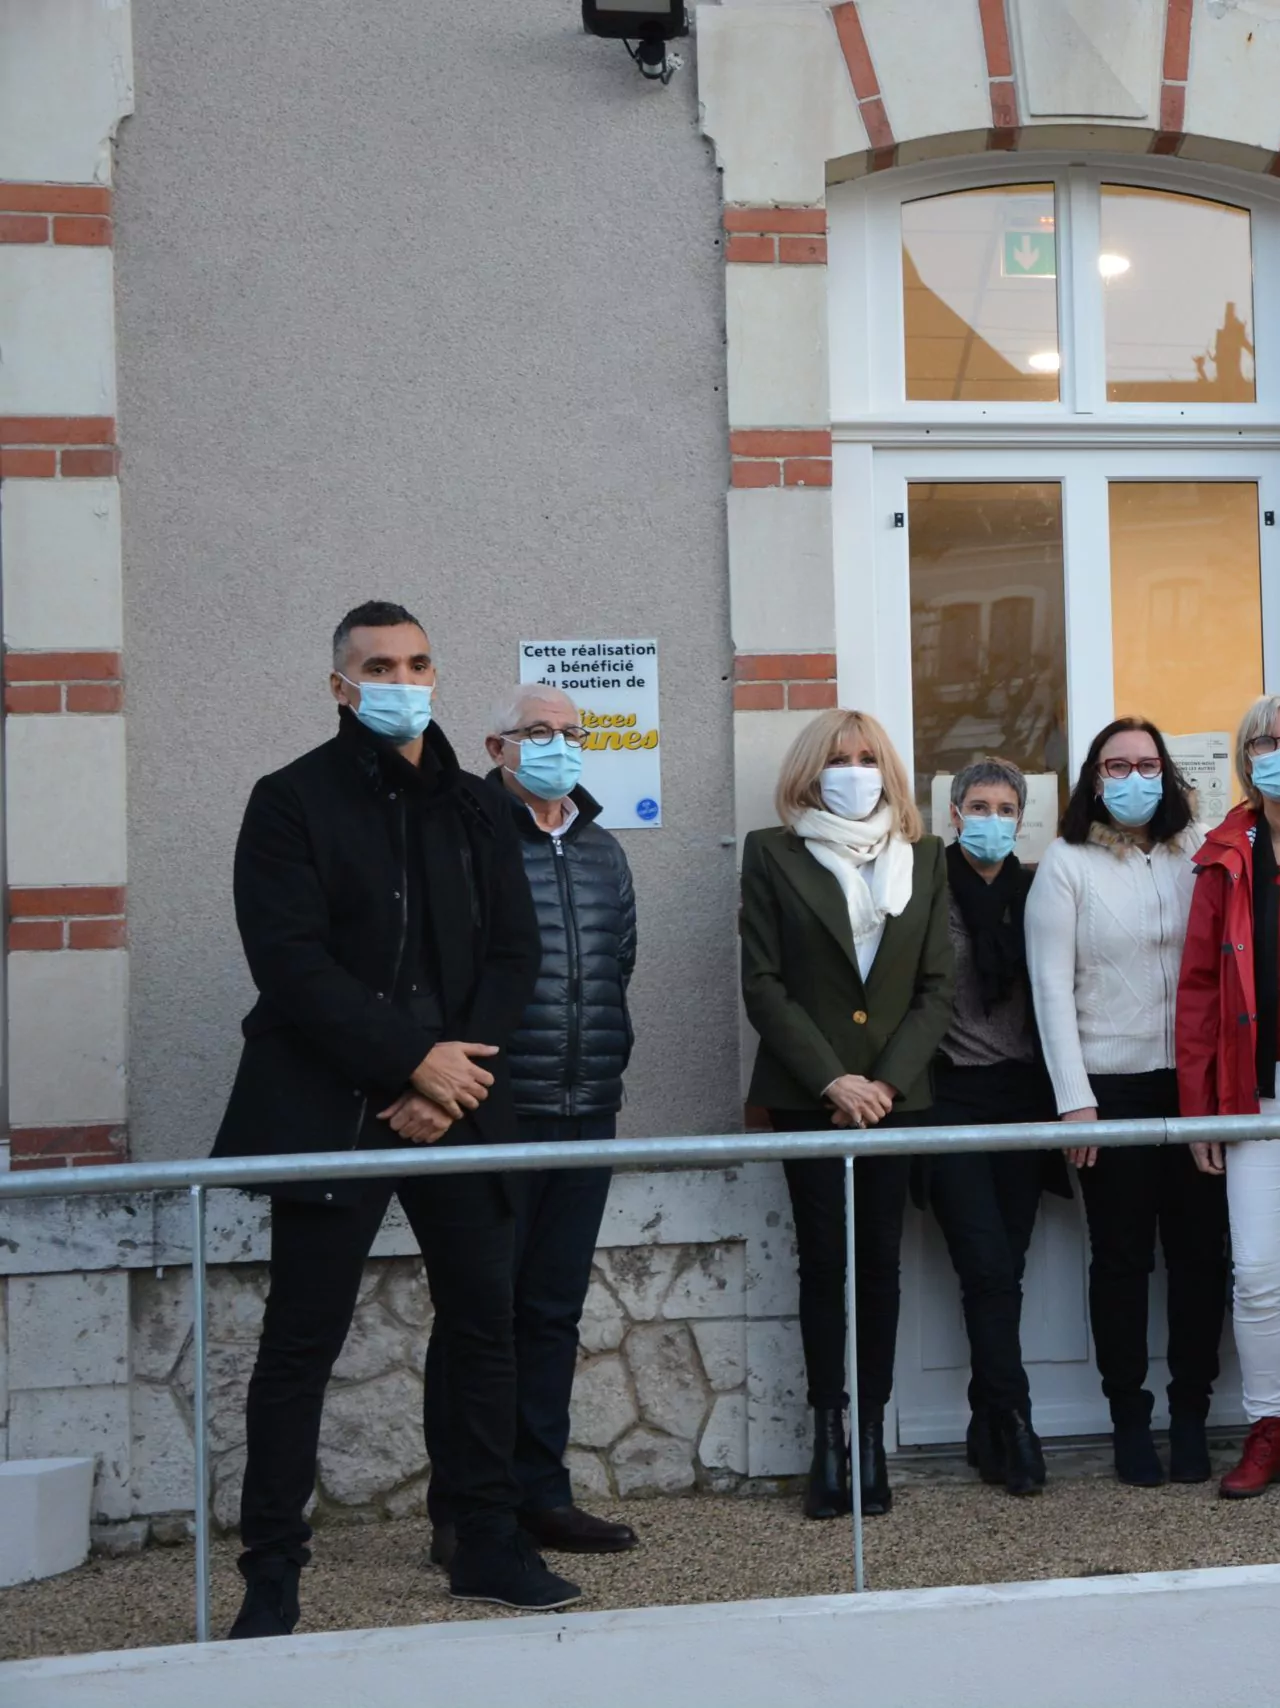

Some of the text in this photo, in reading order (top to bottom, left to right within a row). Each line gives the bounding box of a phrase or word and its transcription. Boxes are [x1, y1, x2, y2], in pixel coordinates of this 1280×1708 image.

[524, 644, 656, 657] Cette réalisation
[547, 660, 634, 673] a bénéficié
[562, 676, 621, 688] soutien
[626, 676, 645, 688] de
[579, 708, 637, 728] ièces
[582, 729, 659, 750] unes
